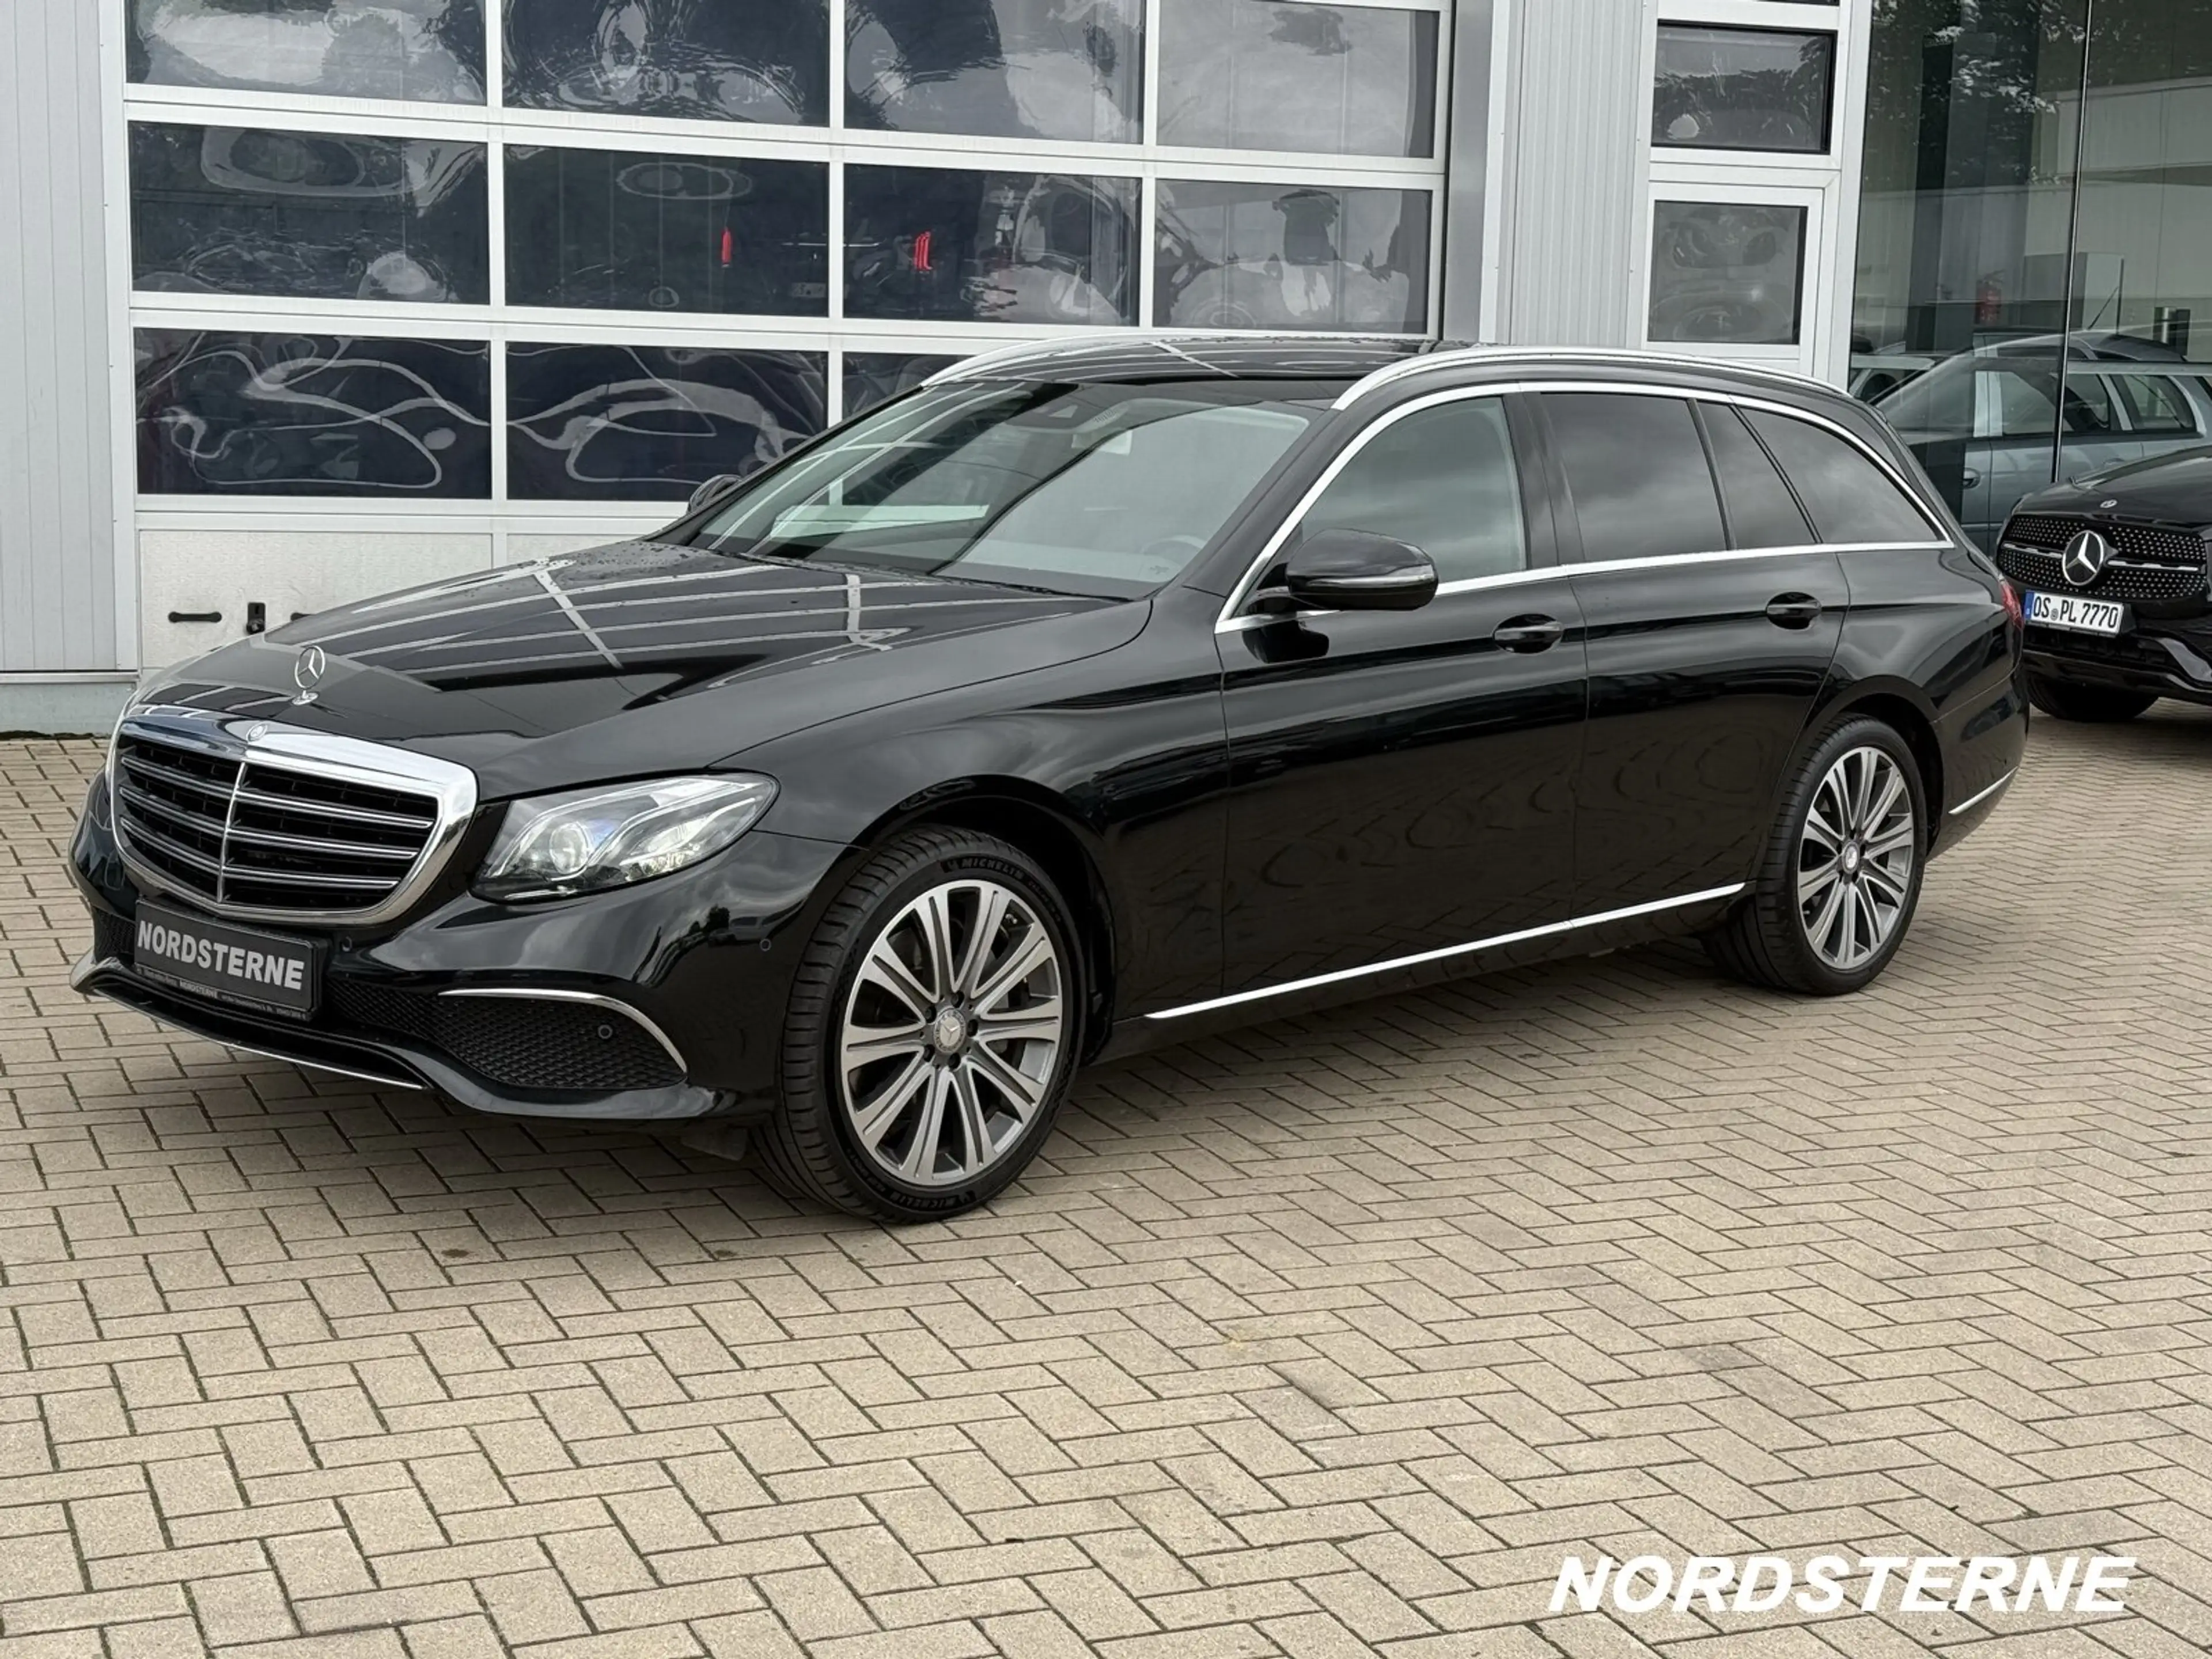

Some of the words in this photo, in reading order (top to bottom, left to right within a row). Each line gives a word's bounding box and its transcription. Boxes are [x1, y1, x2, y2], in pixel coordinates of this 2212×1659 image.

[2033, 596, 2051, 618] OS
[2061, 600, 2076, 622] PL
[2081, 603, 2118, 628] 7770
[961, 858, 1023, 878] MICHELIN
[138, 921, 304, 990] NORDSTERNE
